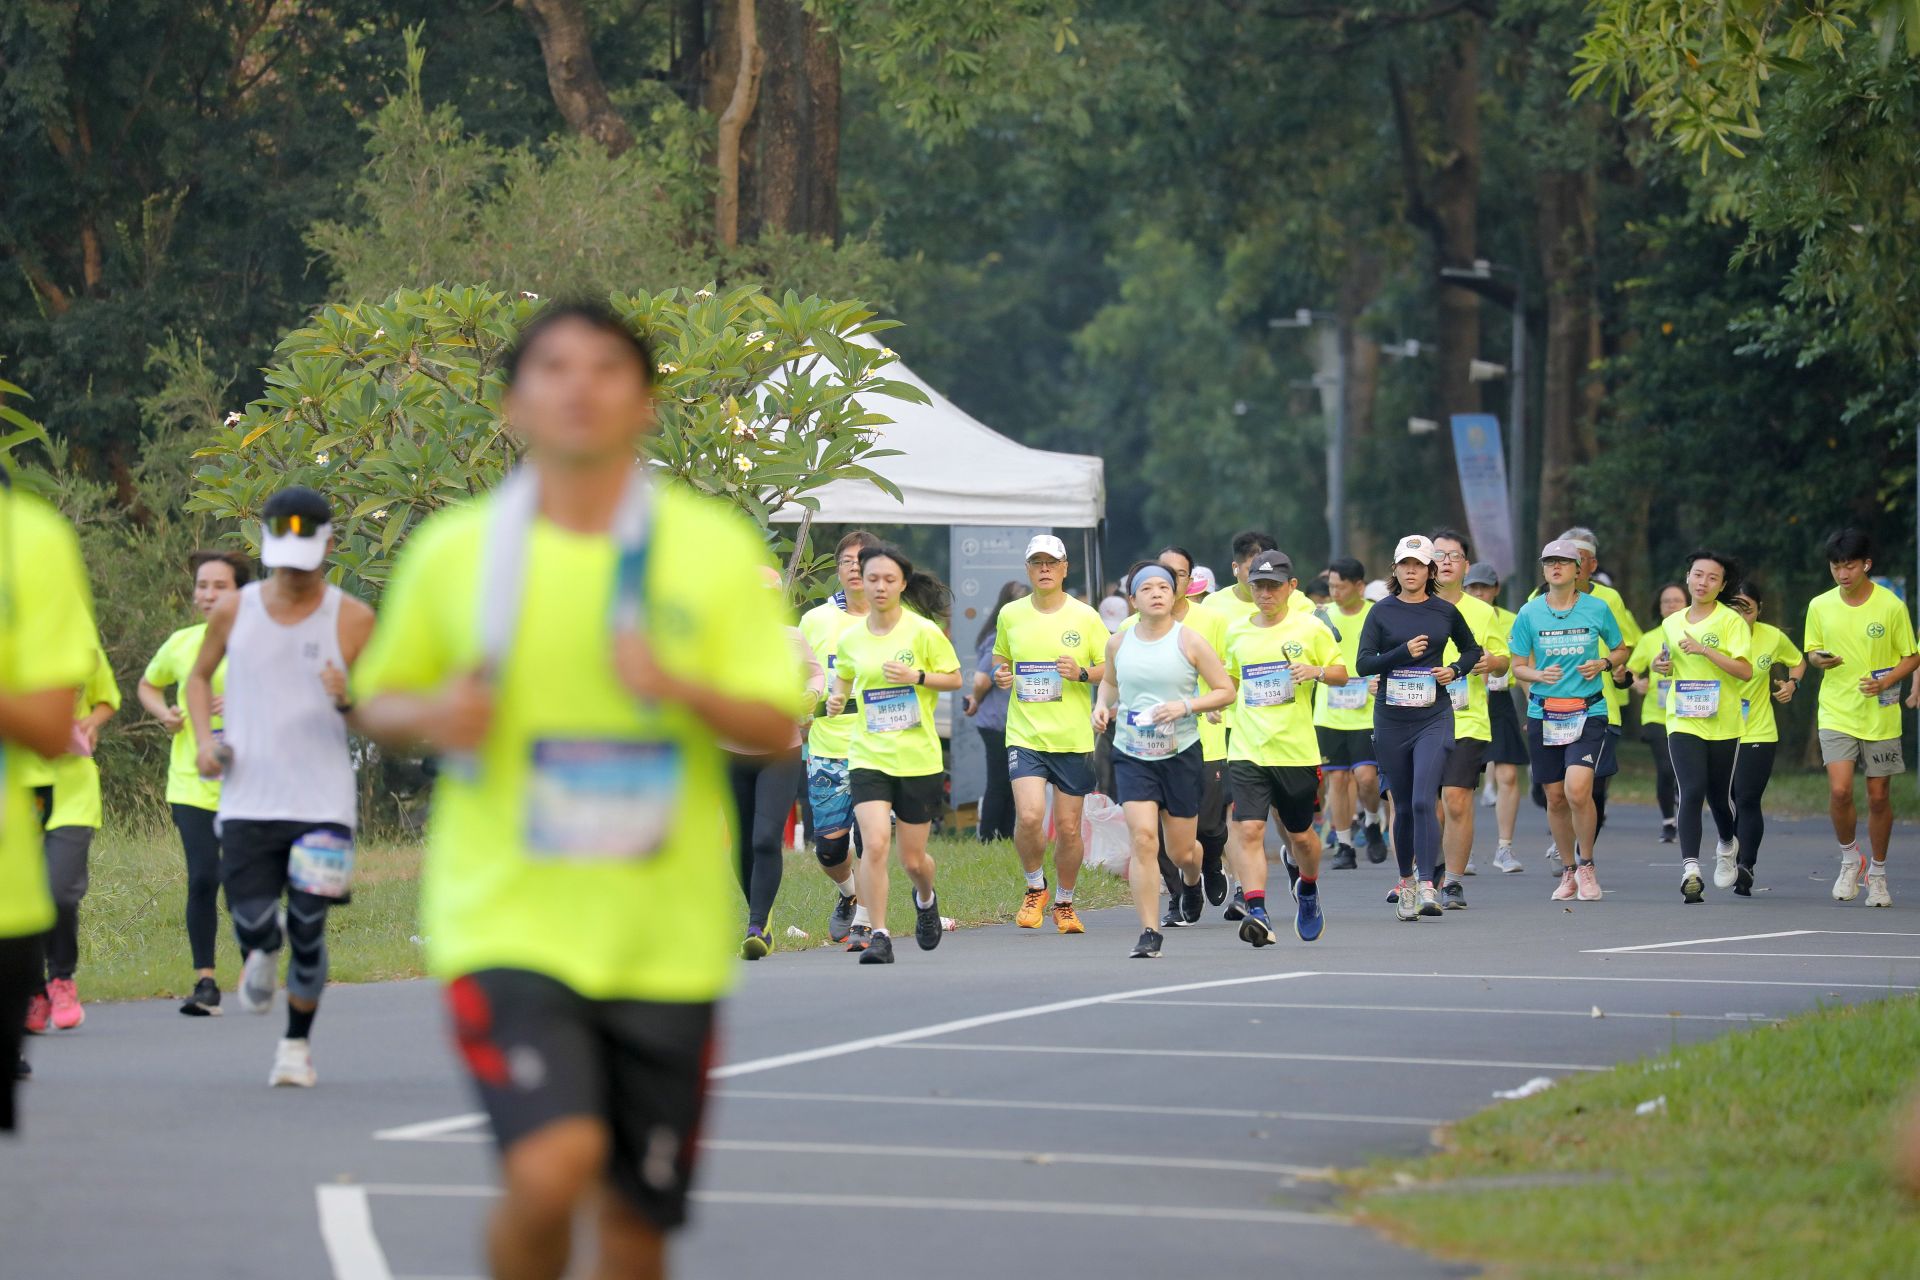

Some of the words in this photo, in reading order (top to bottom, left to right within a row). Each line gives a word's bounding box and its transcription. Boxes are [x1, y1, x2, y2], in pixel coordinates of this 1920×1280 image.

[1264, 690, 1281, 698] 1334
[890, 714, 907, 724] 1043
[1147, 741, 1165, 749] 1076
[1872, 752, 1899, 764] NIKE
